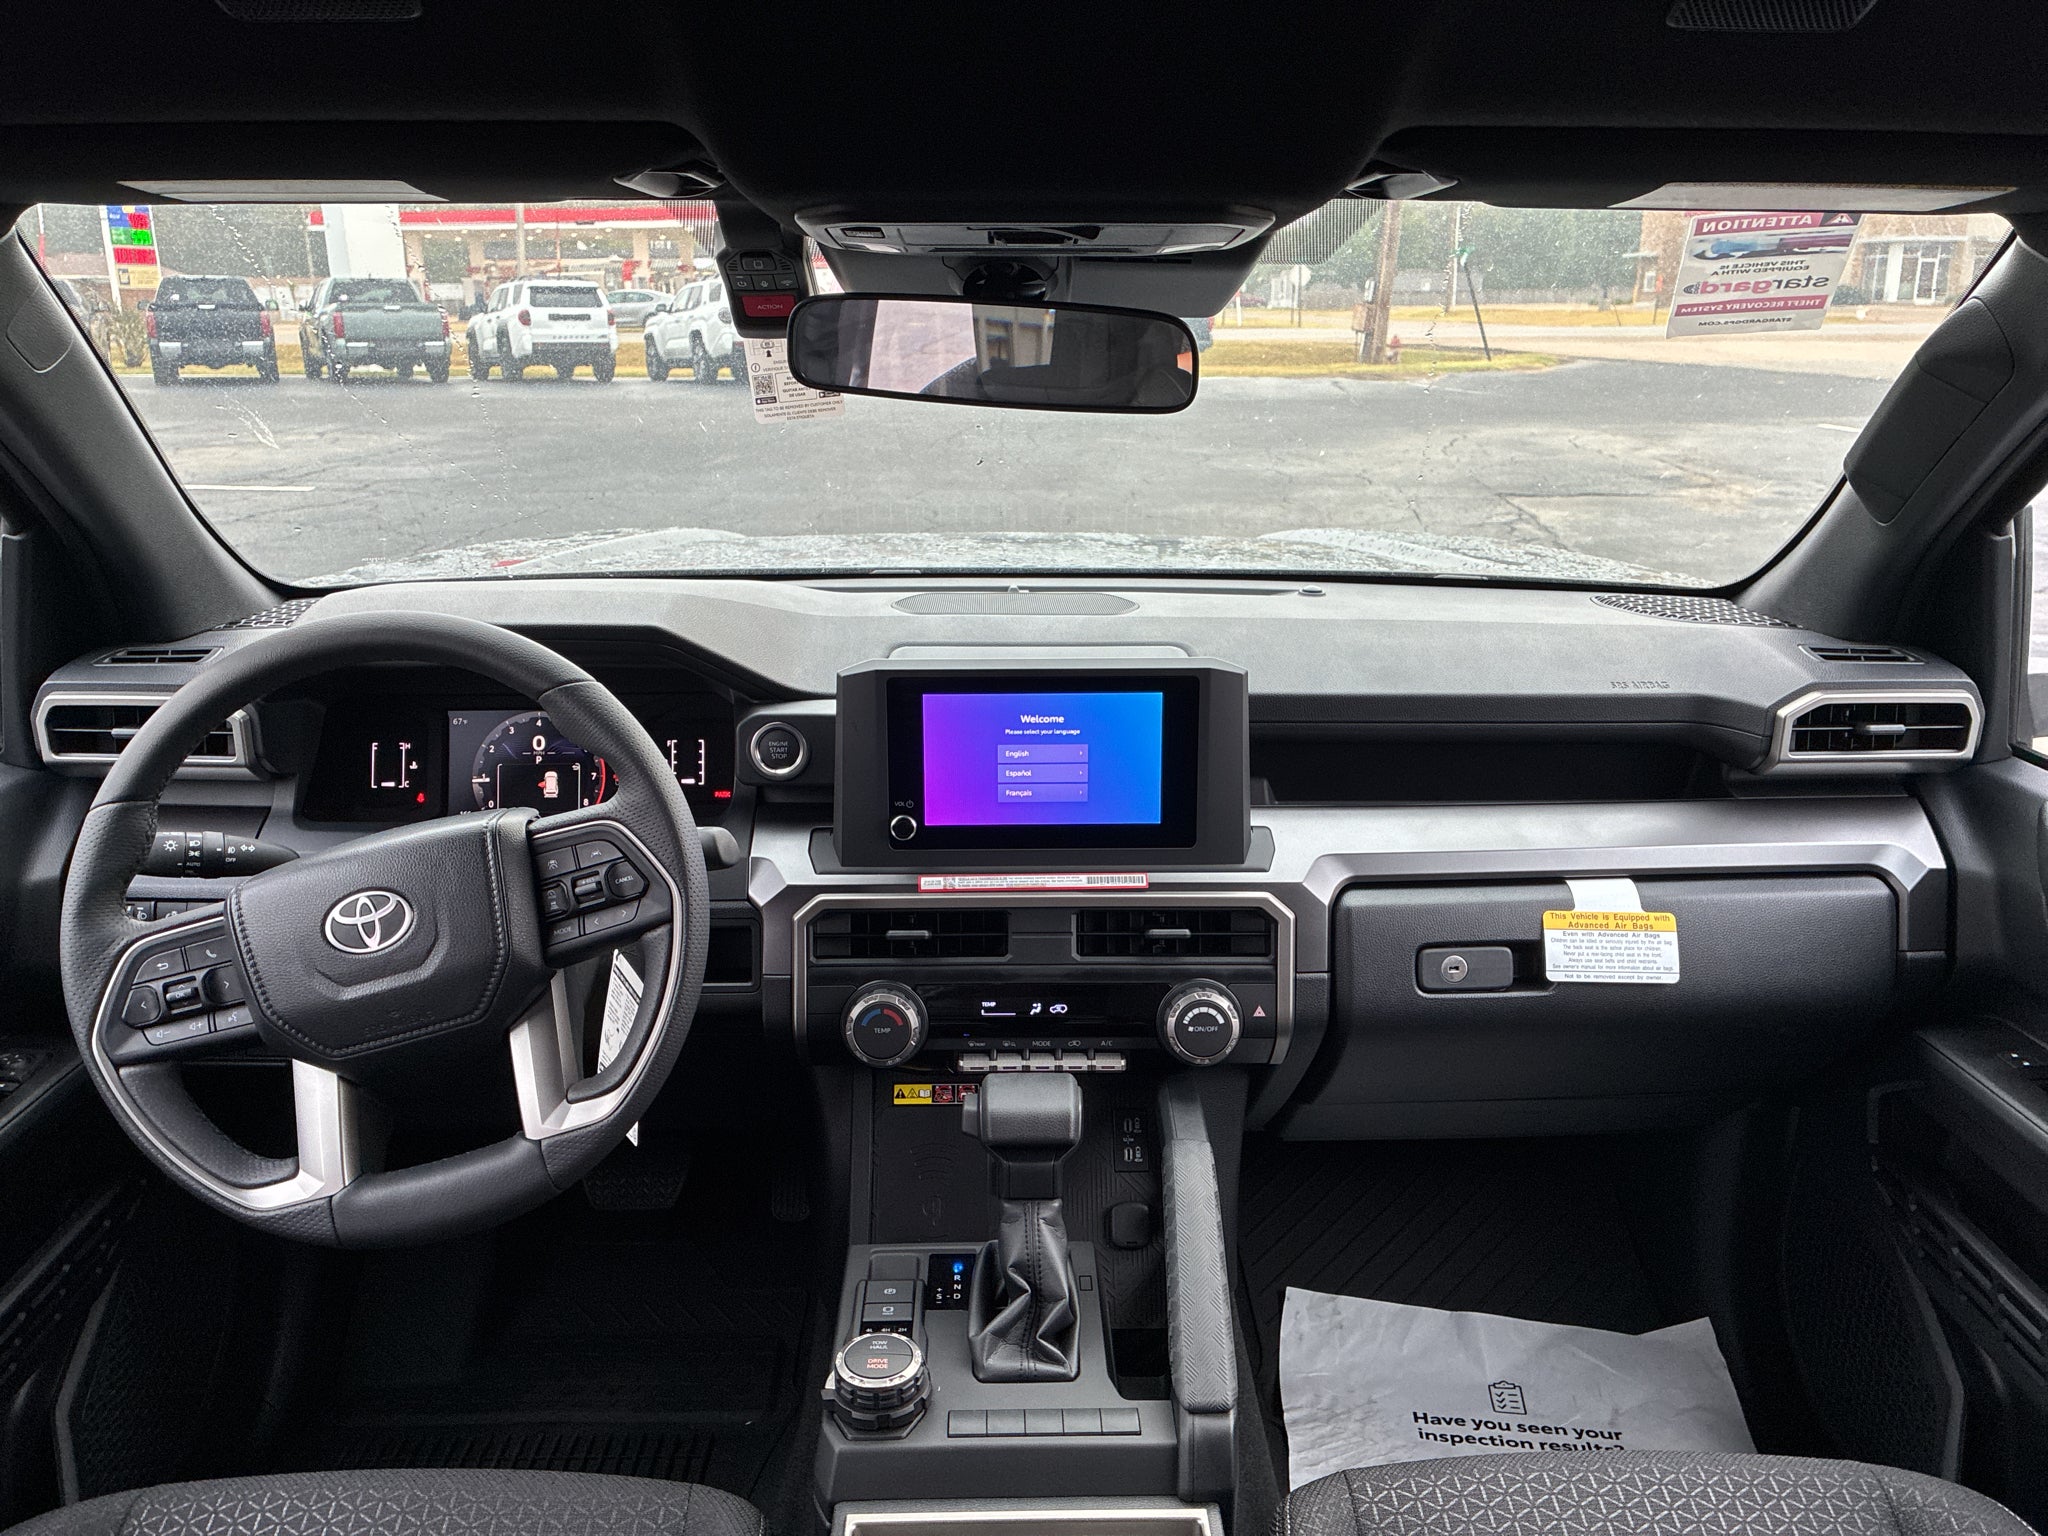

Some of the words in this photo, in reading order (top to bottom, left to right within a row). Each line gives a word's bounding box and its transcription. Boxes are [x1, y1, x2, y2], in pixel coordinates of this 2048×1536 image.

[1020, 714, 1065, 724] Welcome
[1005, 750, 1030, 759] English
[536, 756, 542, 764] P
[1005, 769, 1032, 778] Español
[1005, 789, 1032, 798] Français
[615, 876, 633, 884] CANCEL
[554, 926, 572, 935] MODE
[1412, 1411, 1466, 1427] Have
[1471, 1418, 1512, 1432] you
[1517, 1424, 1568, 1436] seen
[1572, 1427, 1622, 1441] your
[1418, 1428, 1534, 1450] inspection
[1538, 1440, 1625, 1452] result?
